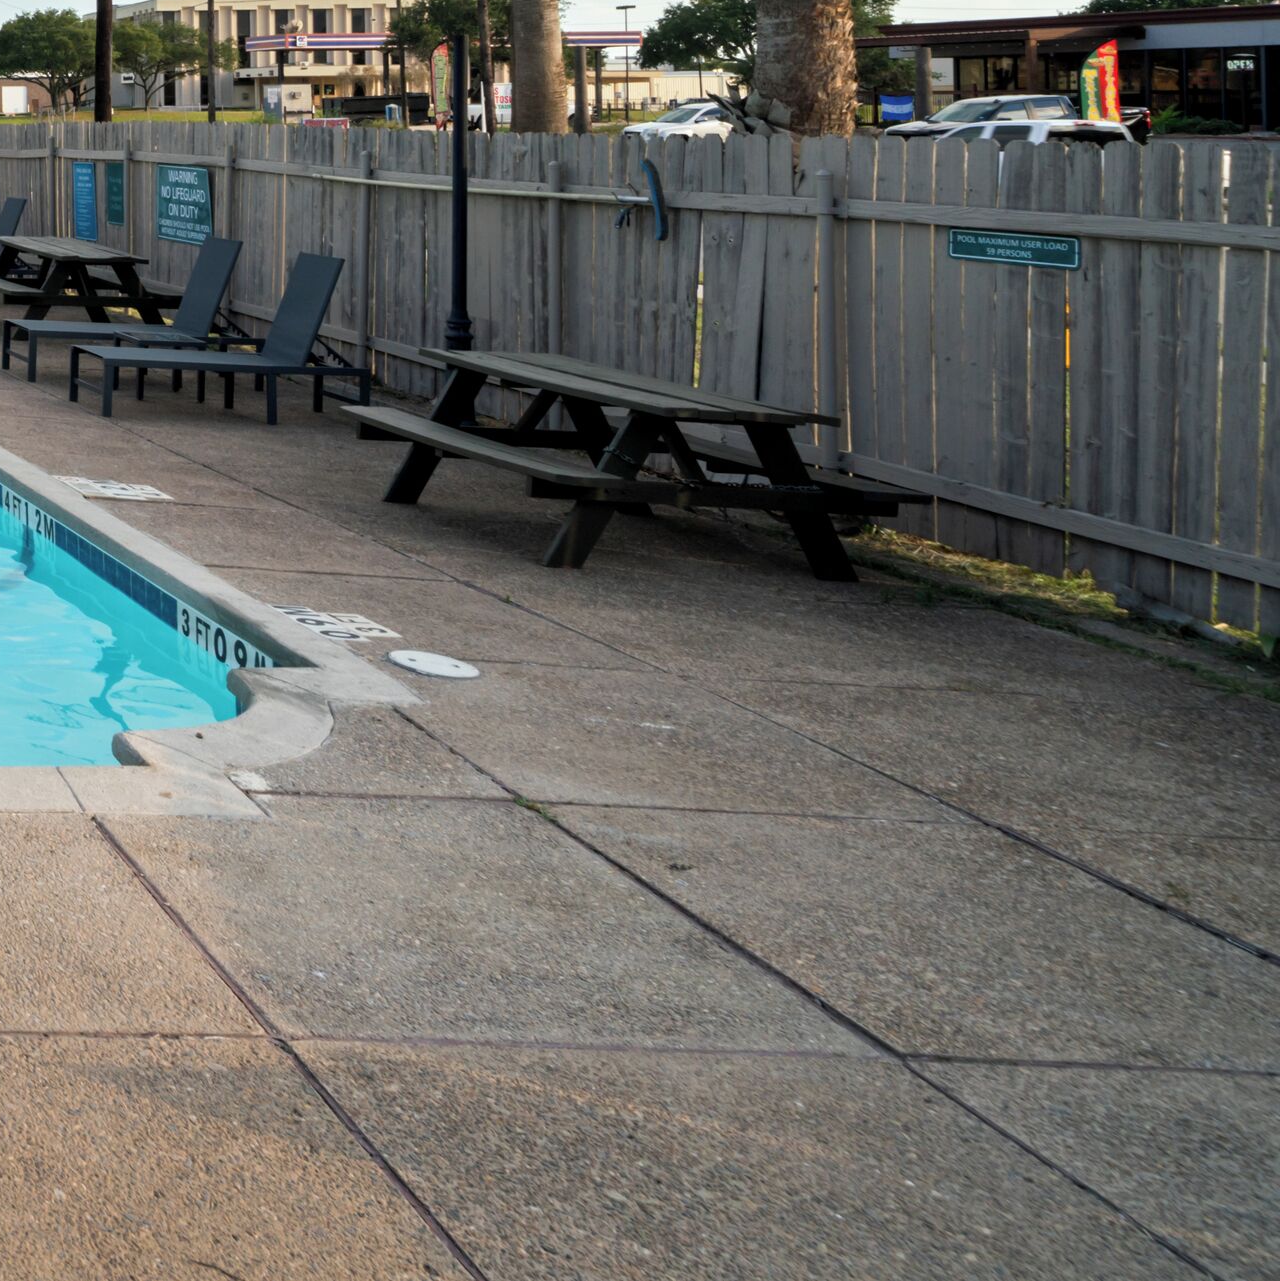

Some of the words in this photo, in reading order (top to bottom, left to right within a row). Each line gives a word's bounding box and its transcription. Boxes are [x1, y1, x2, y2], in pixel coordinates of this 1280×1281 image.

[1227, 60, 1254, 70] OPEN
[168, 170, 198, 185] WARNING
[161, 186, 171, 199] NO
[172, 187, 206, 203] LIFEGUARD
[168, 203, 179, 217] ON
[180, 205, 199, 219] DUTY
[957, 235, 977, 244] POOL
[978, 236, 1019, 247] MAXIMUM
[1021, 239, 1041, 249] USER
[1044, 242, 1068, 251] LOAD
[997, 248, 1032, 259] PERSONS
[4, 490, 10, 513] 4
[12, 495, 22, 521] FT
[182, 608, 190, 638] 3
[195, 616, 211, 653] FT
